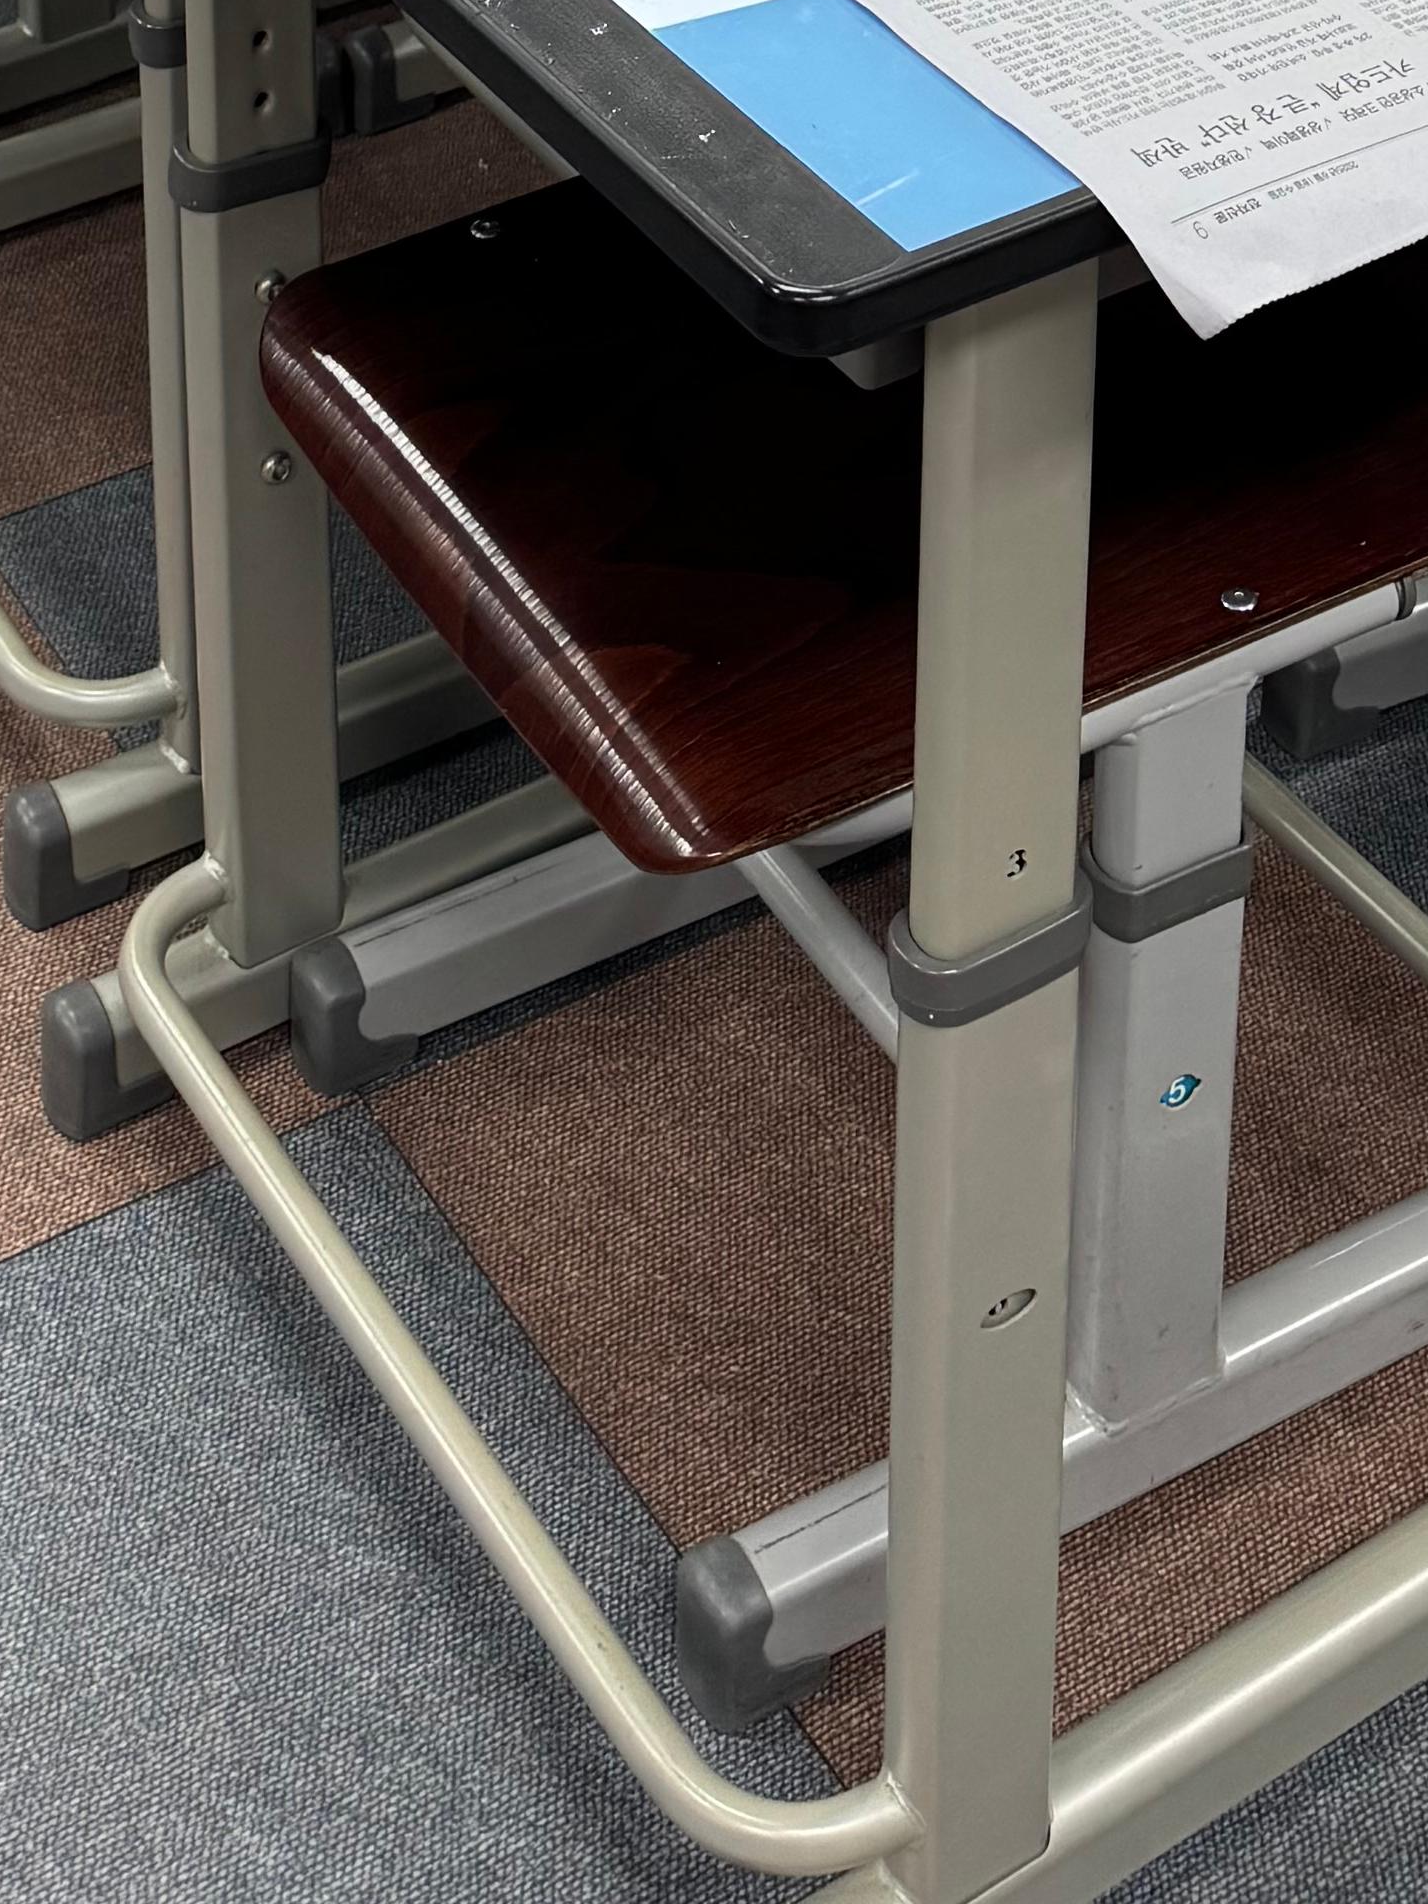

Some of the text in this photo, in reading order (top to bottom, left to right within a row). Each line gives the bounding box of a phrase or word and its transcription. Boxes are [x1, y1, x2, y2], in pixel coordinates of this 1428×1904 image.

[1313, 55, 1418, 102] 카드업계
[1244, 101, 1285, 127] 장
[1336, 101, 1381, 123] 크레딧
[1126, 133, 1193, 168] 반색
[1175, 148, 1248, 179] 민생지원금
[1212, 196, 1262, 224] 전자신문
[1191, 219, 1209, 241] 9
